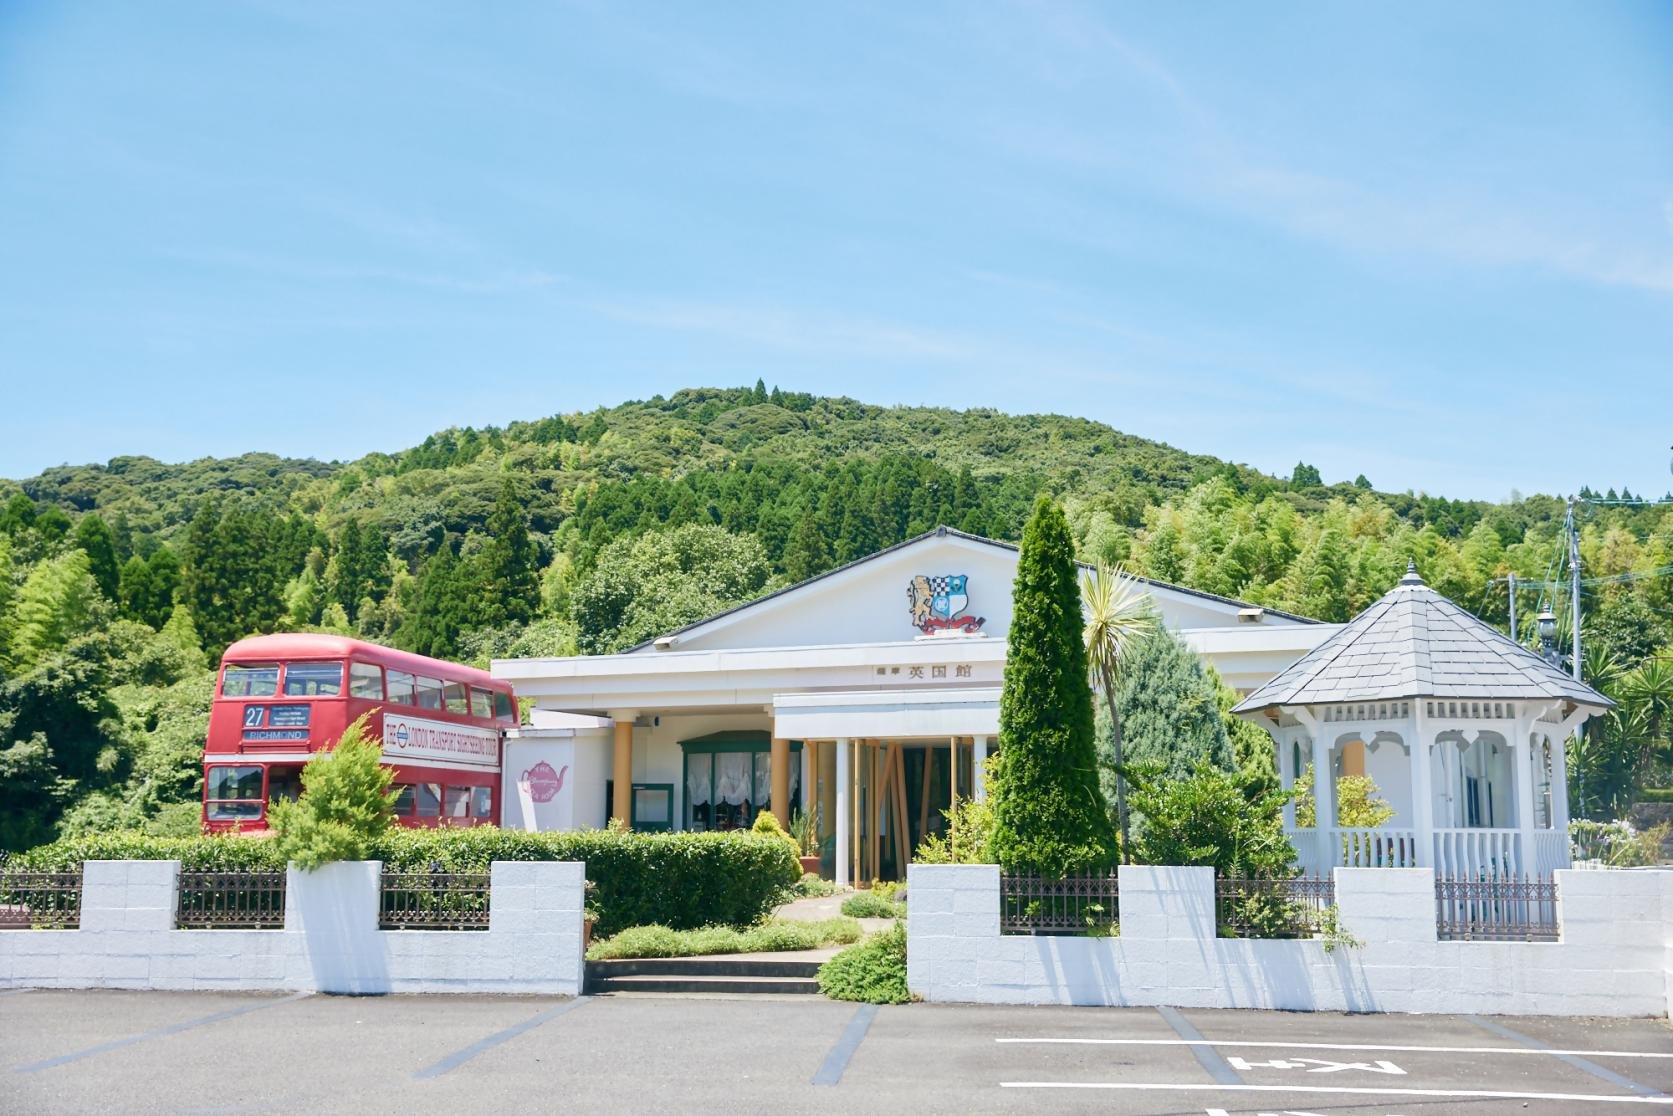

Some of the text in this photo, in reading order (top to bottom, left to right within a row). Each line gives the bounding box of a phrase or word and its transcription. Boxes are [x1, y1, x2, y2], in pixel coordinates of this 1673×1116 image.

[909, 664, 973, 679] 英国館
[245, 707, 265, 726] 27
[249, 730, 302, 740] RICHMOND
[386, 723, 397, 745] THE
[408, 727, 428, 749] LONDON
[429, 730, 457, 752] TRANSPORT
